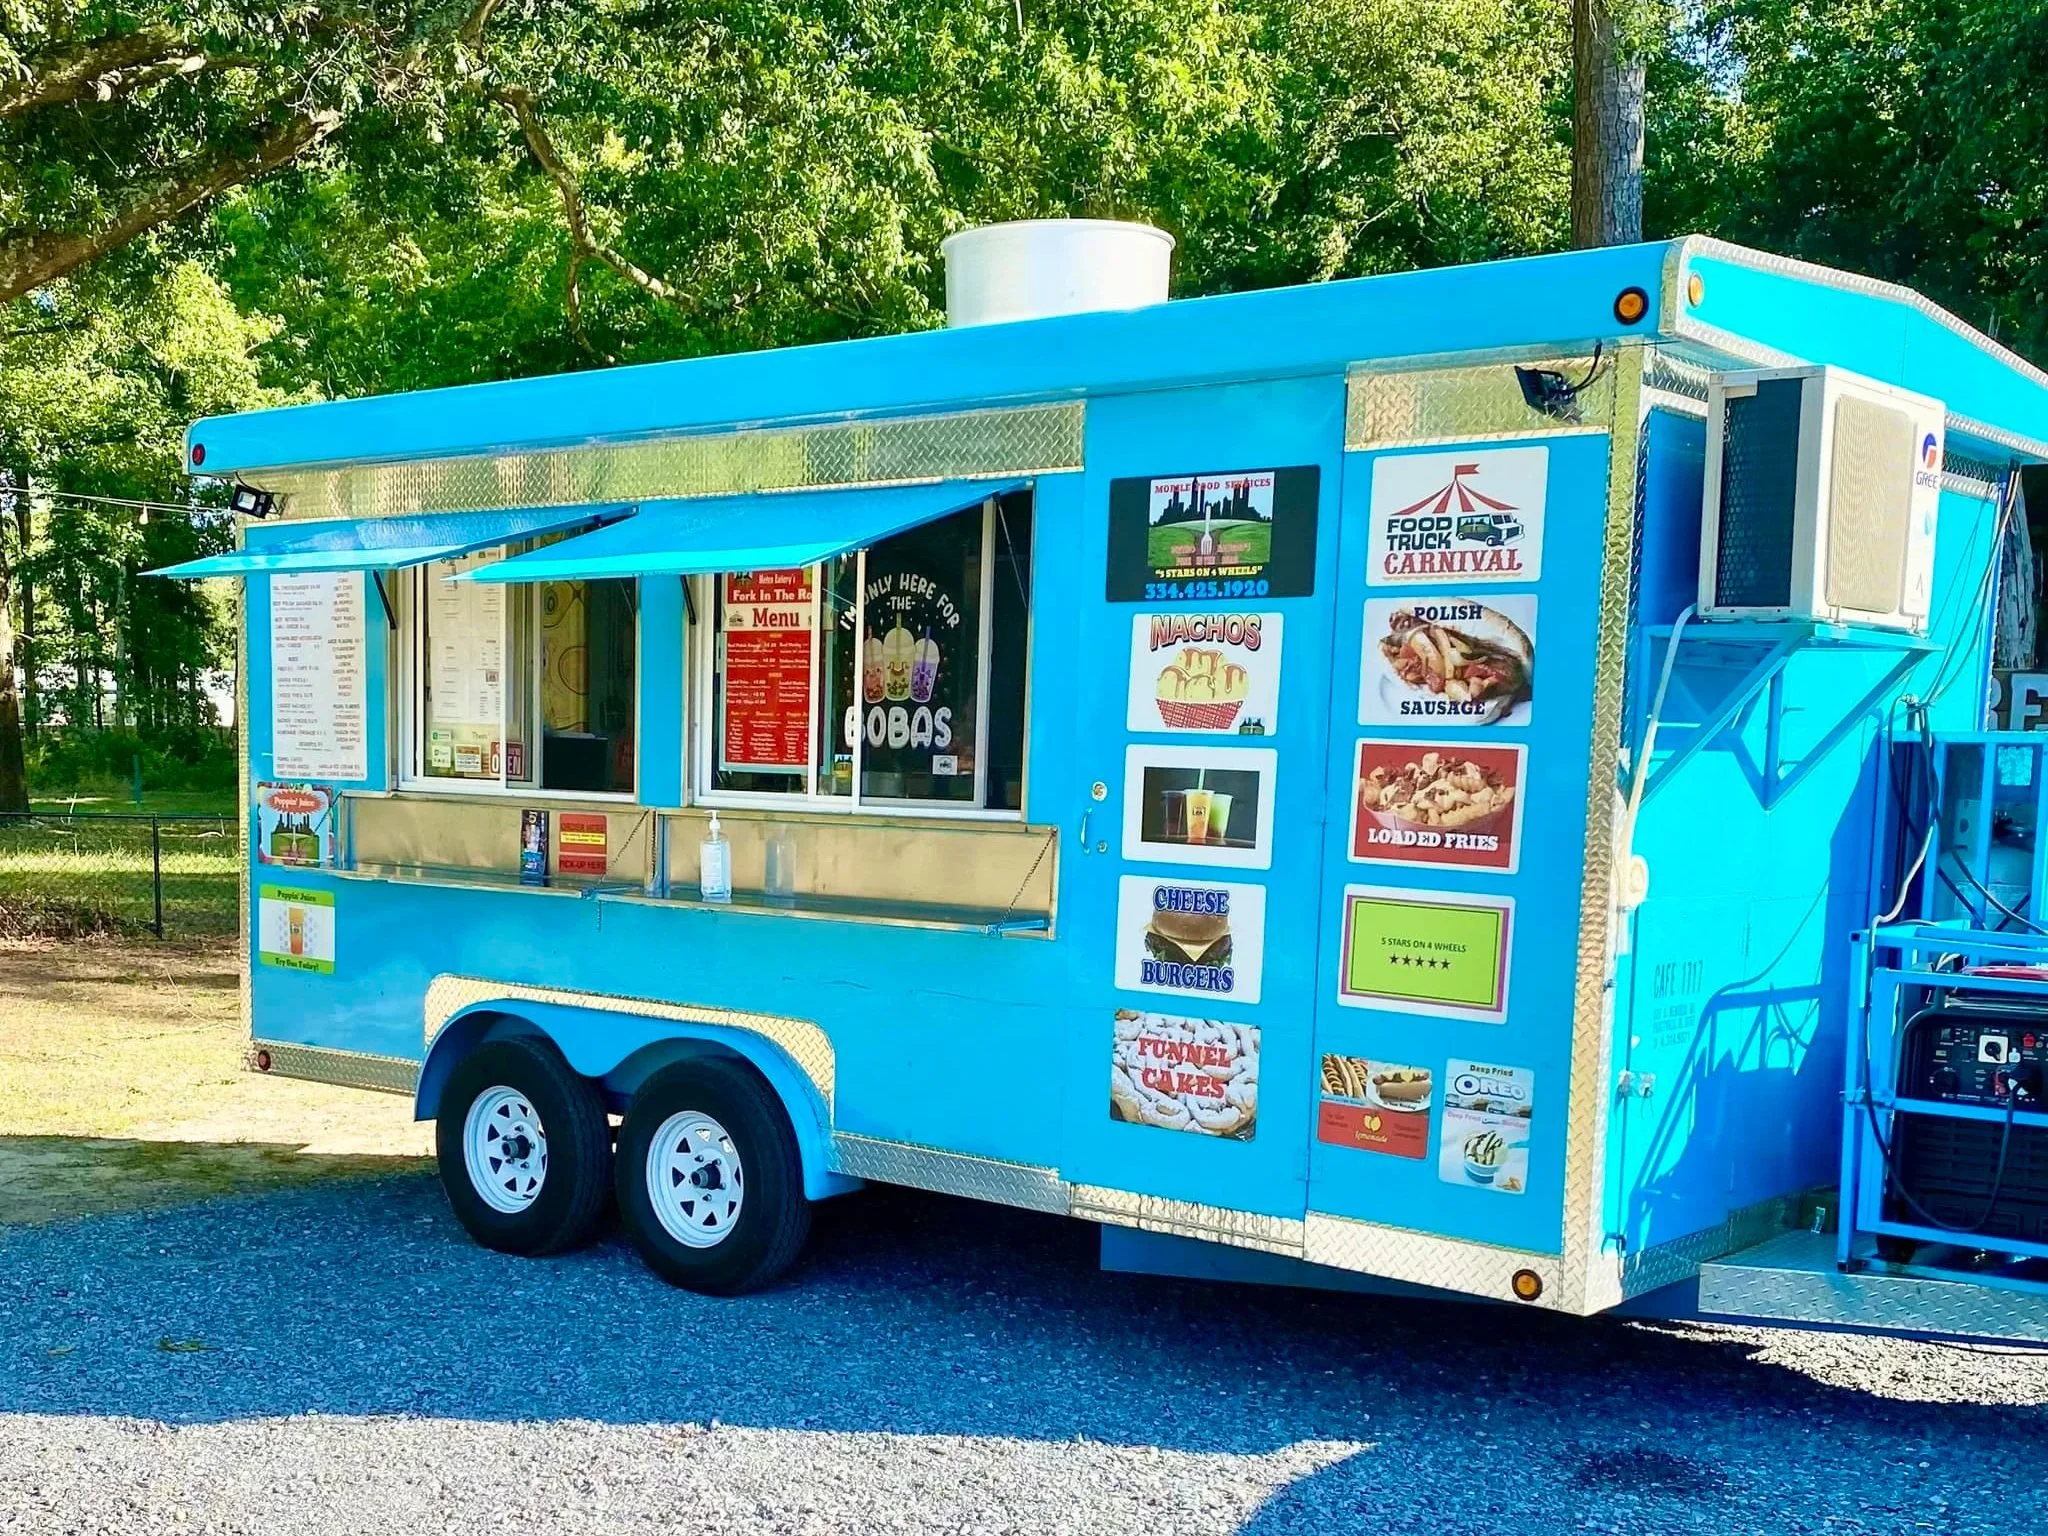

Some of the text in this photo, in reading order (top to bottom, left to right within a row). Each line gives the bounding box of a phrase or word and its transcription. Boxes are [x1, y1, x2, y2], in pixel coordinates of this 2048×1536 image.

[1155, 478, 1271, 494] MOBILE FOOD SERVICES
[1916, 471, 1938, 489] GREE
[1387, 517, 1453, 533] FOOD
[1386, 532, 1453, 550] TRUCK
[1384, 549, 1523, 575] CARNIVAL
[1166, 568, 1196, 578] STARS
[1196, 568, 1210, 576] ON
[733, 589, 756, 601] Fork
[760, 589, 771, 601] In
[773, 588, 795, 600] The
[1145, 580, 1269, 599] 334.425.1920
[900, 572, 937, 599] HERE
[936, 593, 961, 629] FOR
[752, 608, 800, 627] Menu
[1414, 605, 1483, 621] POLISH
[1150, 614, 1262, 651] NACHOS
[1400, 701, 1486, 715] SAUSAGE
[844, 706, 952, 748] BOBAS
[492, 754, 521, 775] OEN
[1368, 828, 1499, 851] LOADED FRIES
[1153, 886, 1230, 915] CHEESE
[1381, 937, 1467, 953] 5 STARS ON 4 WHEELS
[1142, 959, 1234, 992] BURGERS
[1654, 962, 1676, 998] CAFE
[1138, 1037, 1231, 1068] FUNNEL
[1470, 1065, 1513, 1077] Deep Fried
[1141, 1068, 1226, 1099] CAKES
[1455, 1074, 1525, 1100] OREO
[1355, 1130, 1388, 1143] Lemonade
